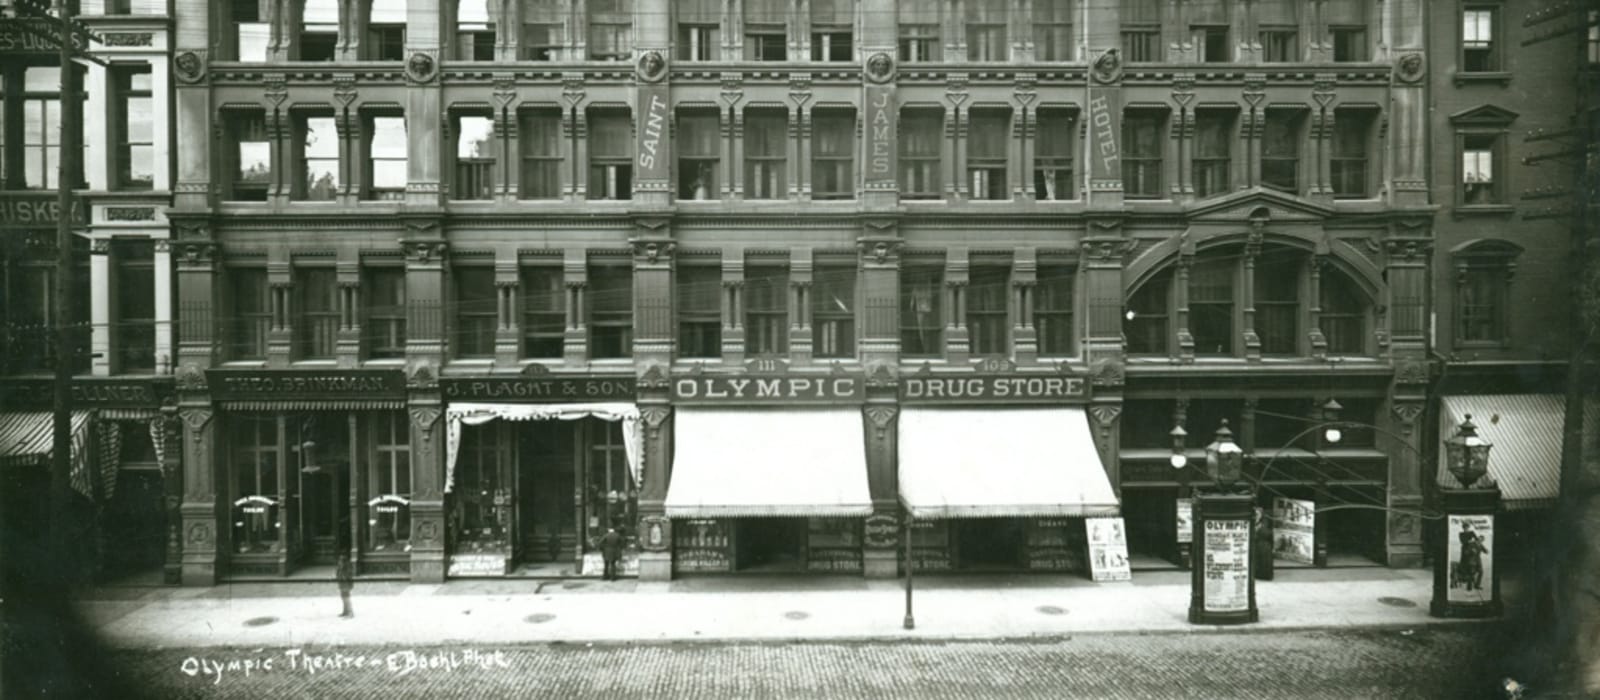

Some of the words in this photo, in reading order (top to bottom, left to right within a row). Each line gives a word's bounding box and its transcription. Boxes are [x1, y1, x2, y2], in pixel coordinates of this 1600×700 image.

[640, 96, 666, 170] SAINT
[873, 93, 888, 173] JAMES
[1091, 96, 1118, 176] HOTEL
[983, 360, 1009, 371] 109
[447, 382, 467, 396] J.
[562, 382, 577, 395] &
[676, 379, 855, 398] OLYMPIC
[905, 379, 985, 397] DRUG
[992, 378, 1085, 397] STORE
[1206, 521, 1248, 530] OLYMPIC
